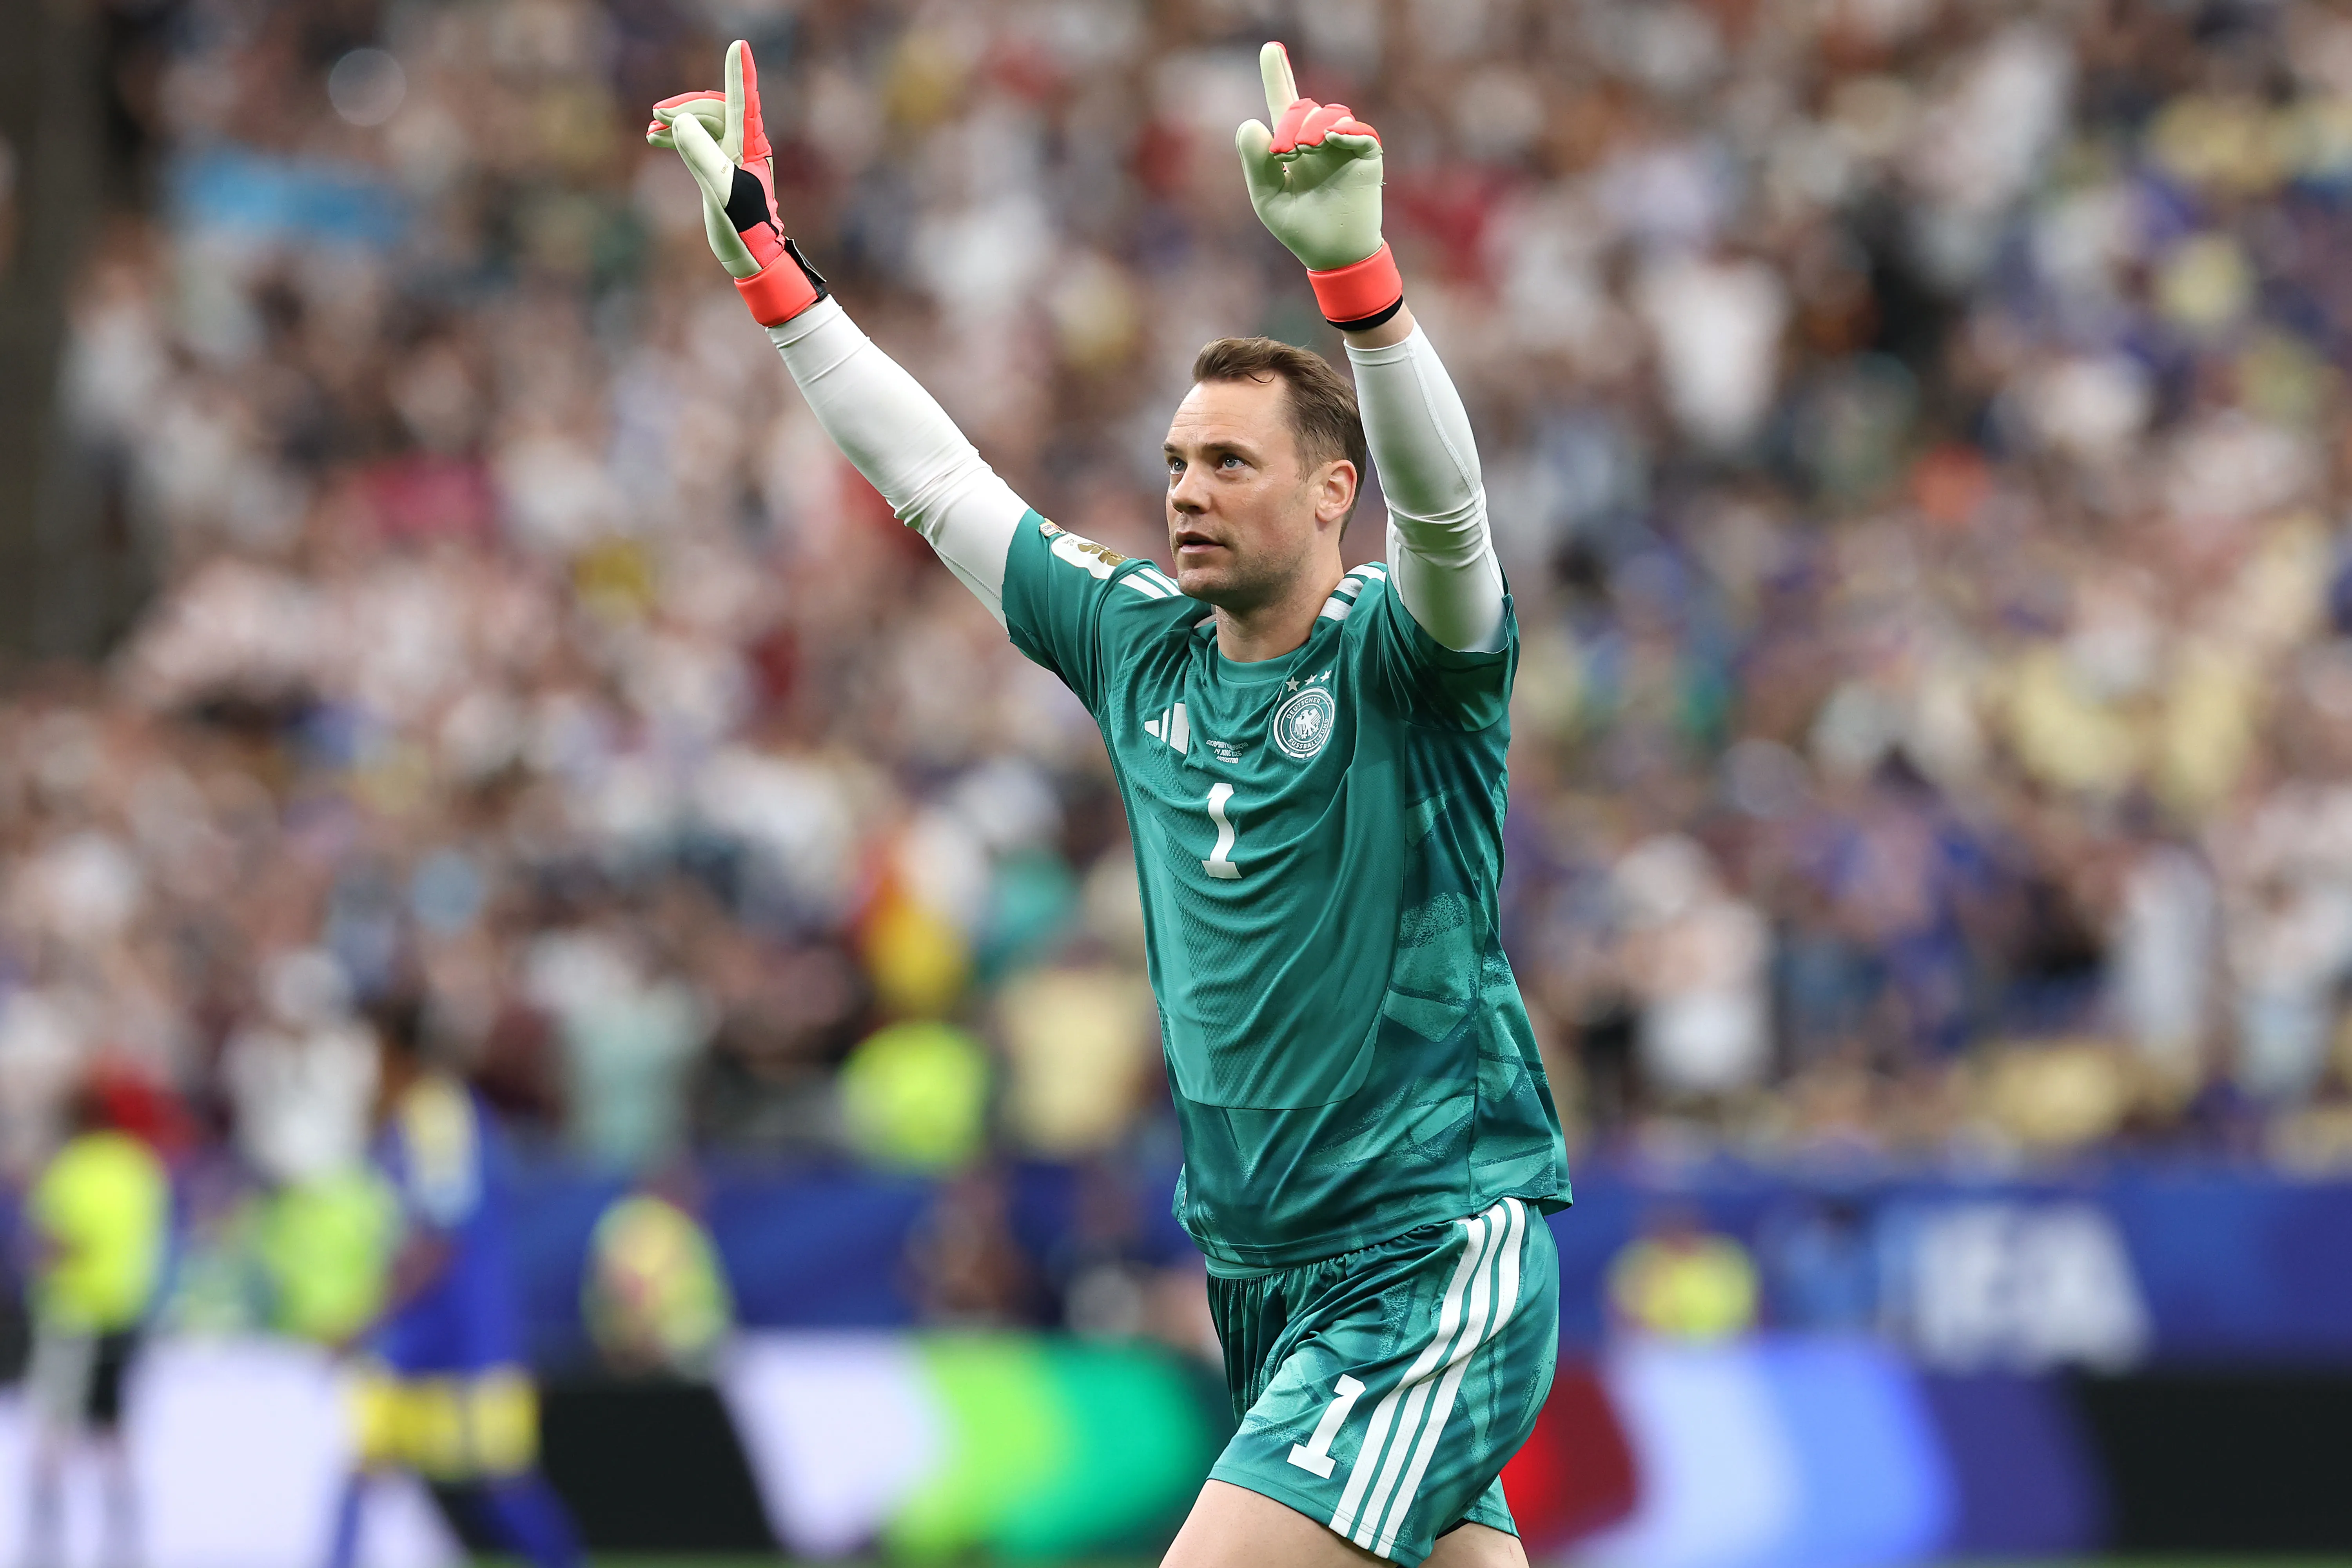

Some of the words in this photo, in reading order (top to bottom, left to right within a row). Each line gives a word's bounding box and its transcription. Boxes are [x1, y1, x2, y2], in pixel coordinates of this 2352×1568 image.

[1286, 697, 1321, 719] DEUTSCHER
[1216, 755, 1239, 764] HOUSTON
[1202, 782, 1242, 879] 1
[1286, 1374, 1367, 1480] 1
